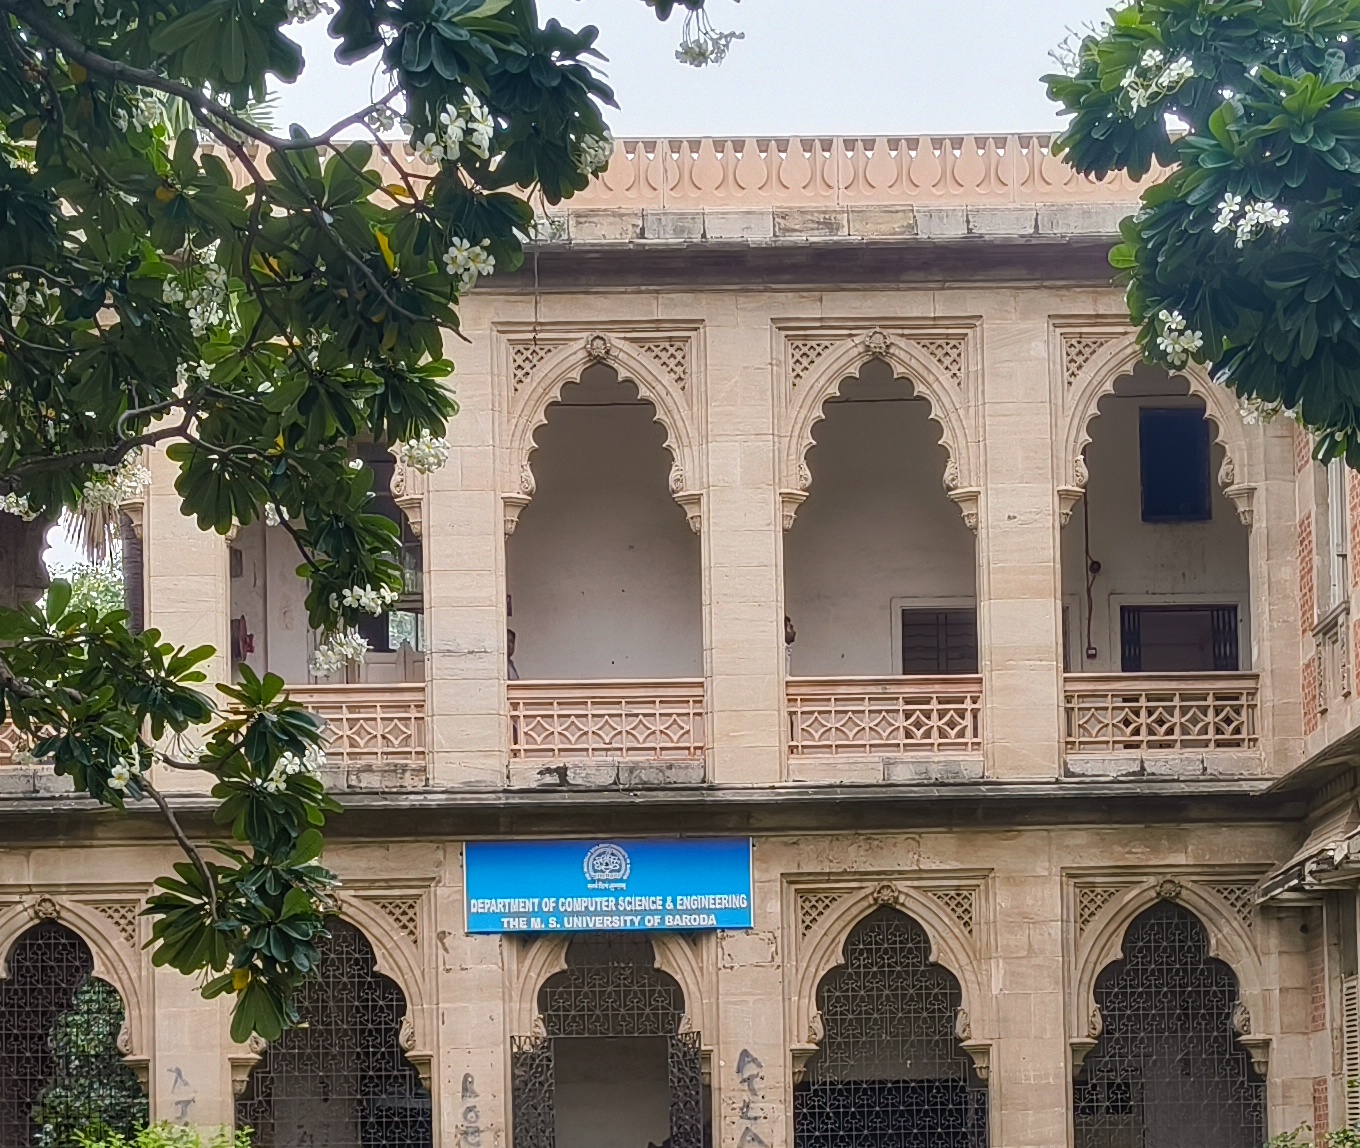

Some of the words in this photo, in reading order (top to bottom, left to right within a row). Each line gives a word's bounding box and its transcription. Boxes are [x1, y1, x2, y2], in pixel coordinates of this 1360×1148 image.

[470, 898, 539, 913] DEPARTMENT
[542, 897, 557, 911] OF
[558, 896, 616, 911] COMPUTER
[618, 895, 663, 910] SCIENCE
[665, 896, 674, 910] &
[676, 893, 748, 910] ENGINEERING
[501, 917, 527, 929] THE
[530, 917, 545, 929] M.
[549, 916, 561, 928] S.
[564, 915, 641, 928] UNIVERSITY
[644, 915, 661, 927] OF
[665, 914, 717, 927] BARODA
